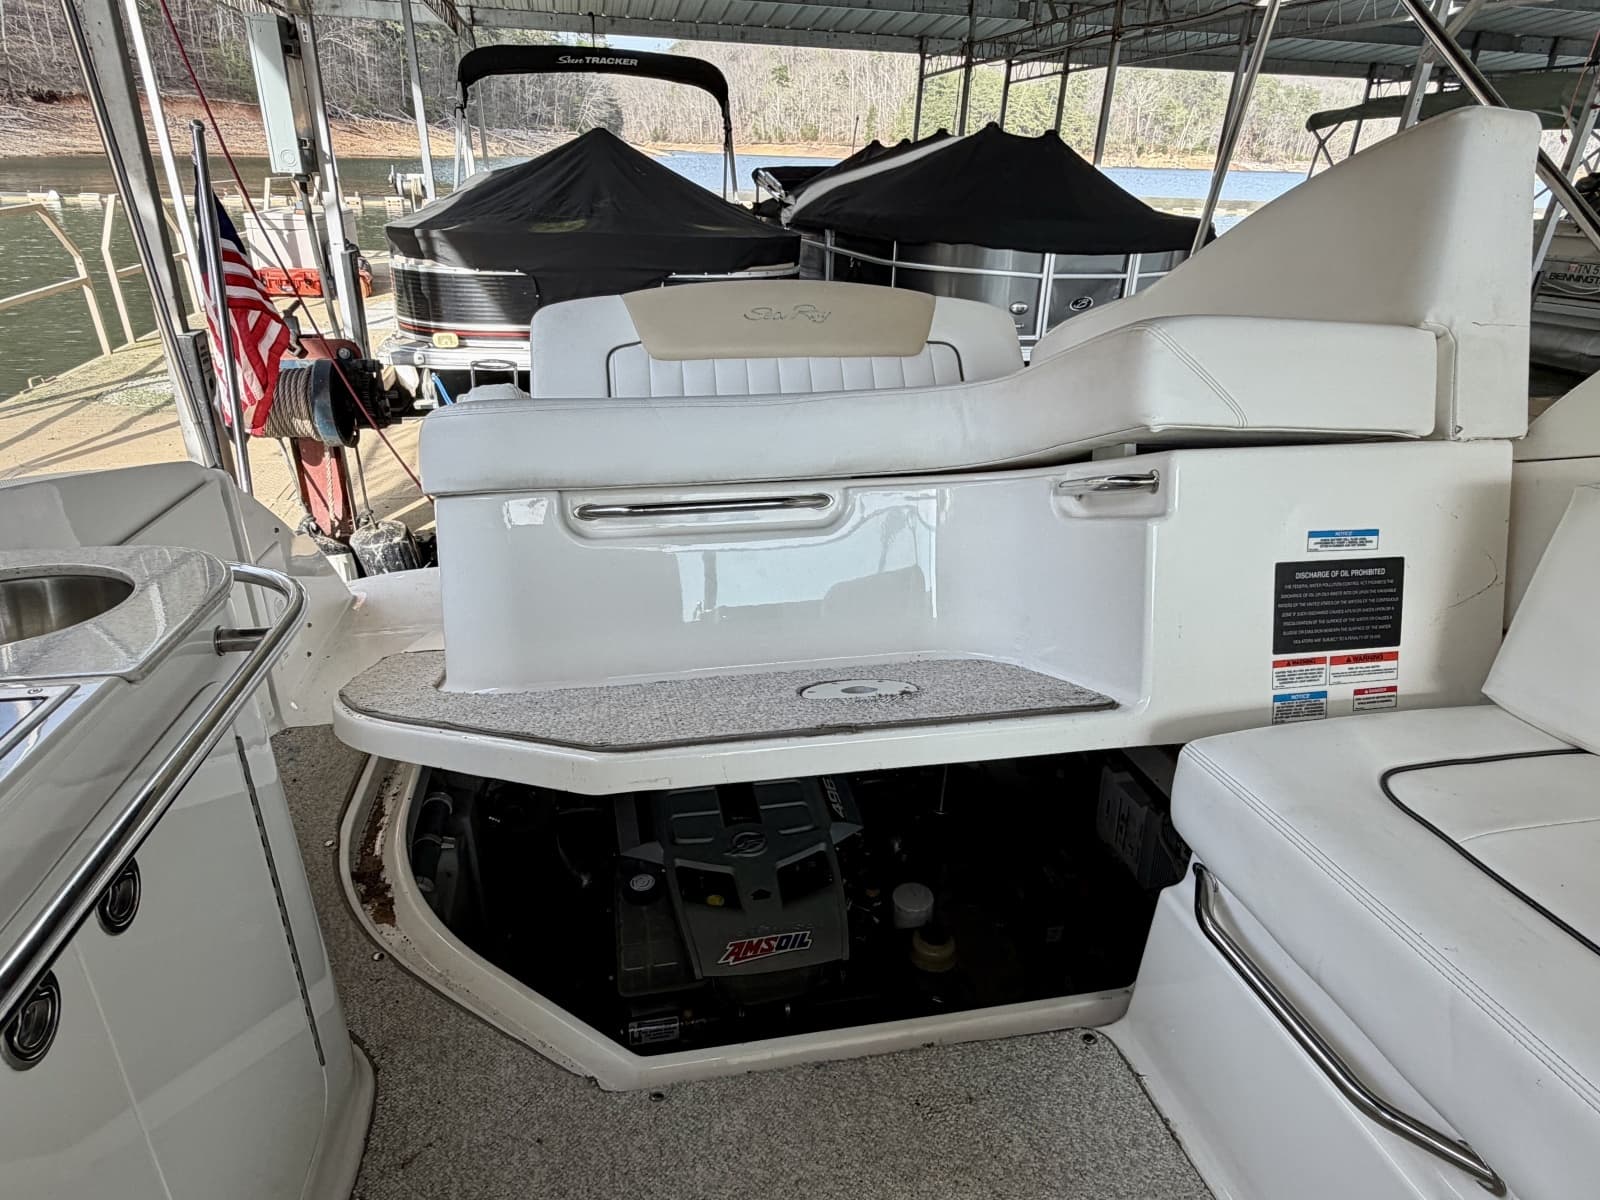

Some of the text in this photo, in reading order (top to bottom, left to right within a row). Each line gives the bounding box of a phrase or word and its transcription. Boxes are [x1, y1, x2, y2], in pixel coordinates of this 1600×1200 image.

[556, 55, 638, 66] Sun TRACKER
[1549, 272, 1600, 284] BENNINGT
[1295, 571, 1330, 579] DISCHARGE
[1340, 569, 1350, 577] OIL
[1350, 568, 1386, 577] PROHIBITED
[718, 931, 812, 965] AMSOIL
